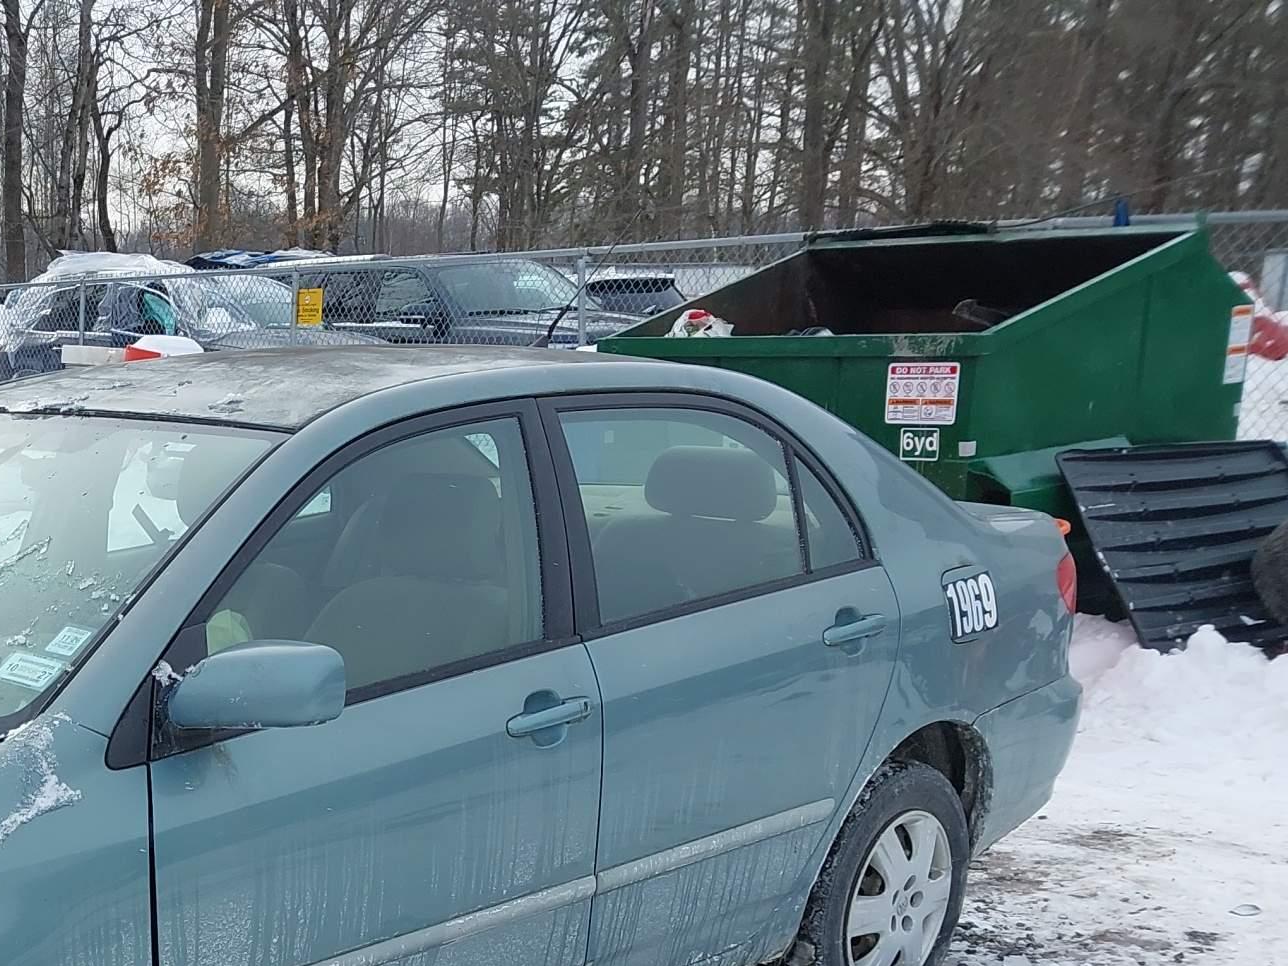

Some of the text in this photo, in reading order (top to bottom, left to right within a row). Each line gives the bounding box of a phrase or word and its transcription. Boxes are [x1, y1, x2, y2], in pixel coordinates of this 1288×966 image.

[895, 366, 952, 374] DO NOT PARK
[903, 432, 937, 456] 6yd
[946, 573, 998, 638] 1969
